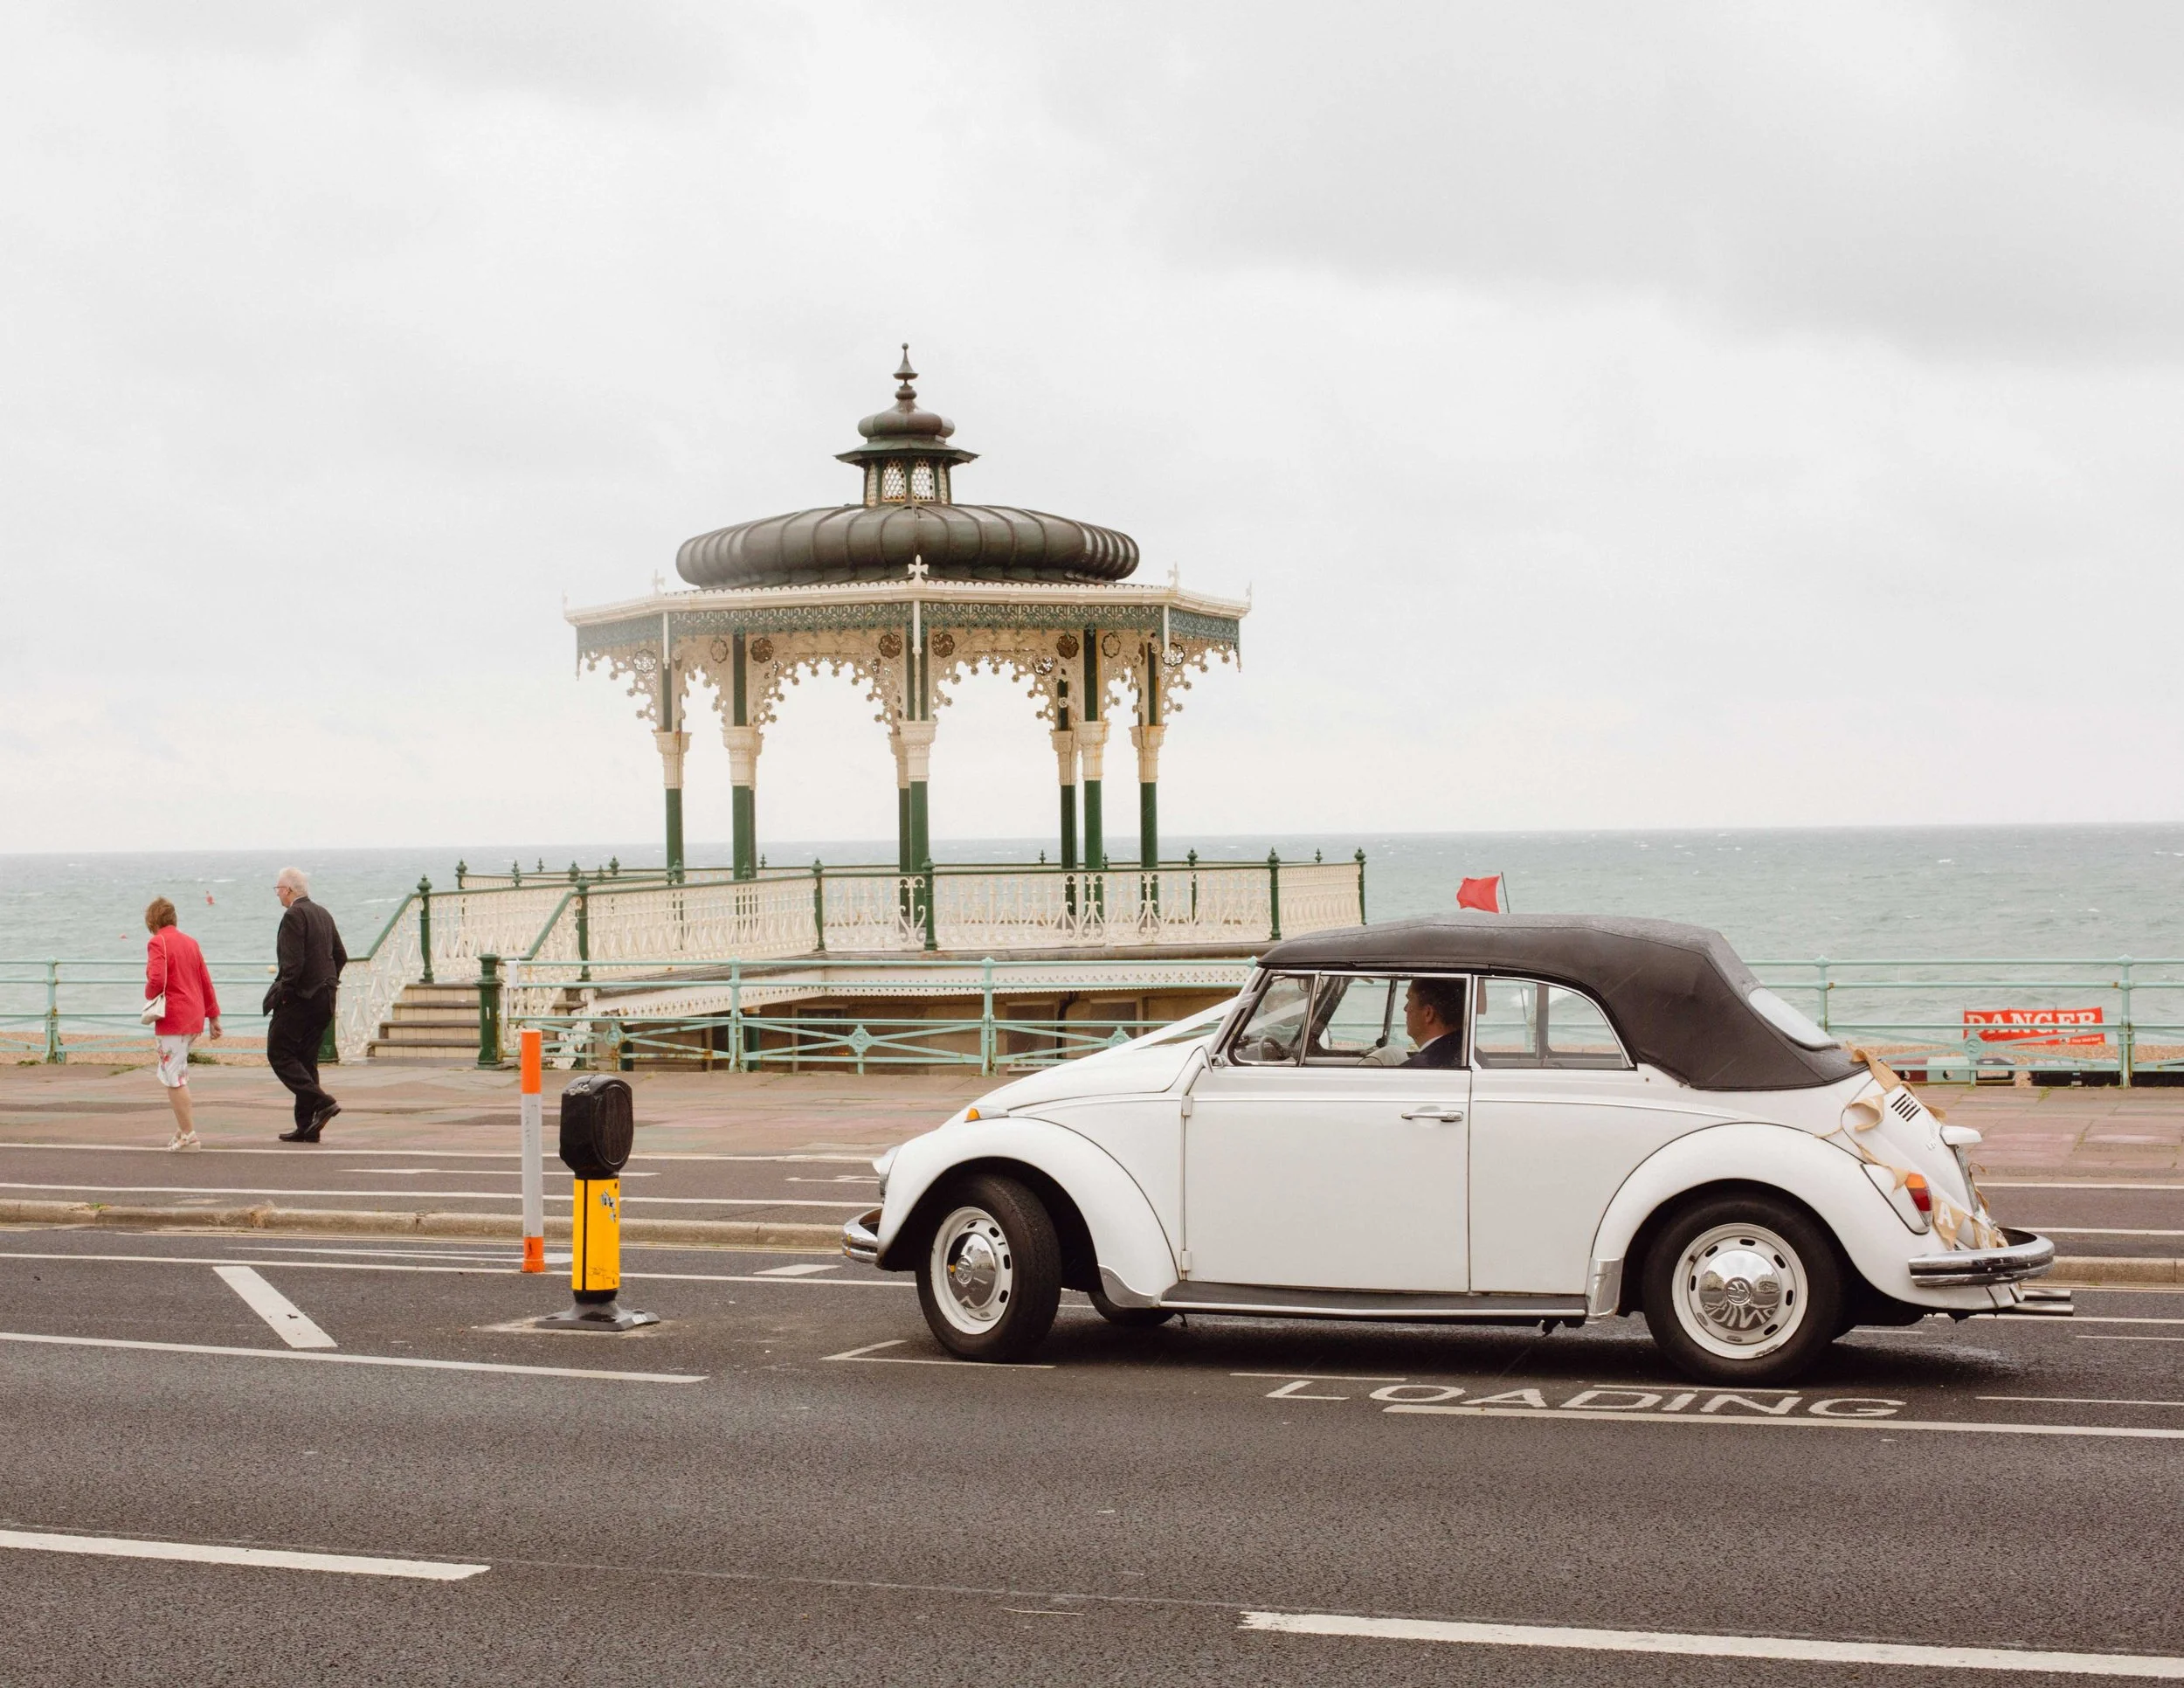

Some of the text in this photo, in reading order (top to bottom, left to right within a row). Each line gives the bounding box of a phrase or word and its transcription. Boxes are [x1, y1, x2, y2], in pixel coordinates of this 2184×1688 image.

[1966, 1012, 2096, 1034] DANGER
[1937, 1201, 1956, 1229] A
[1265, 1380, 1907, 1417] LOADING
